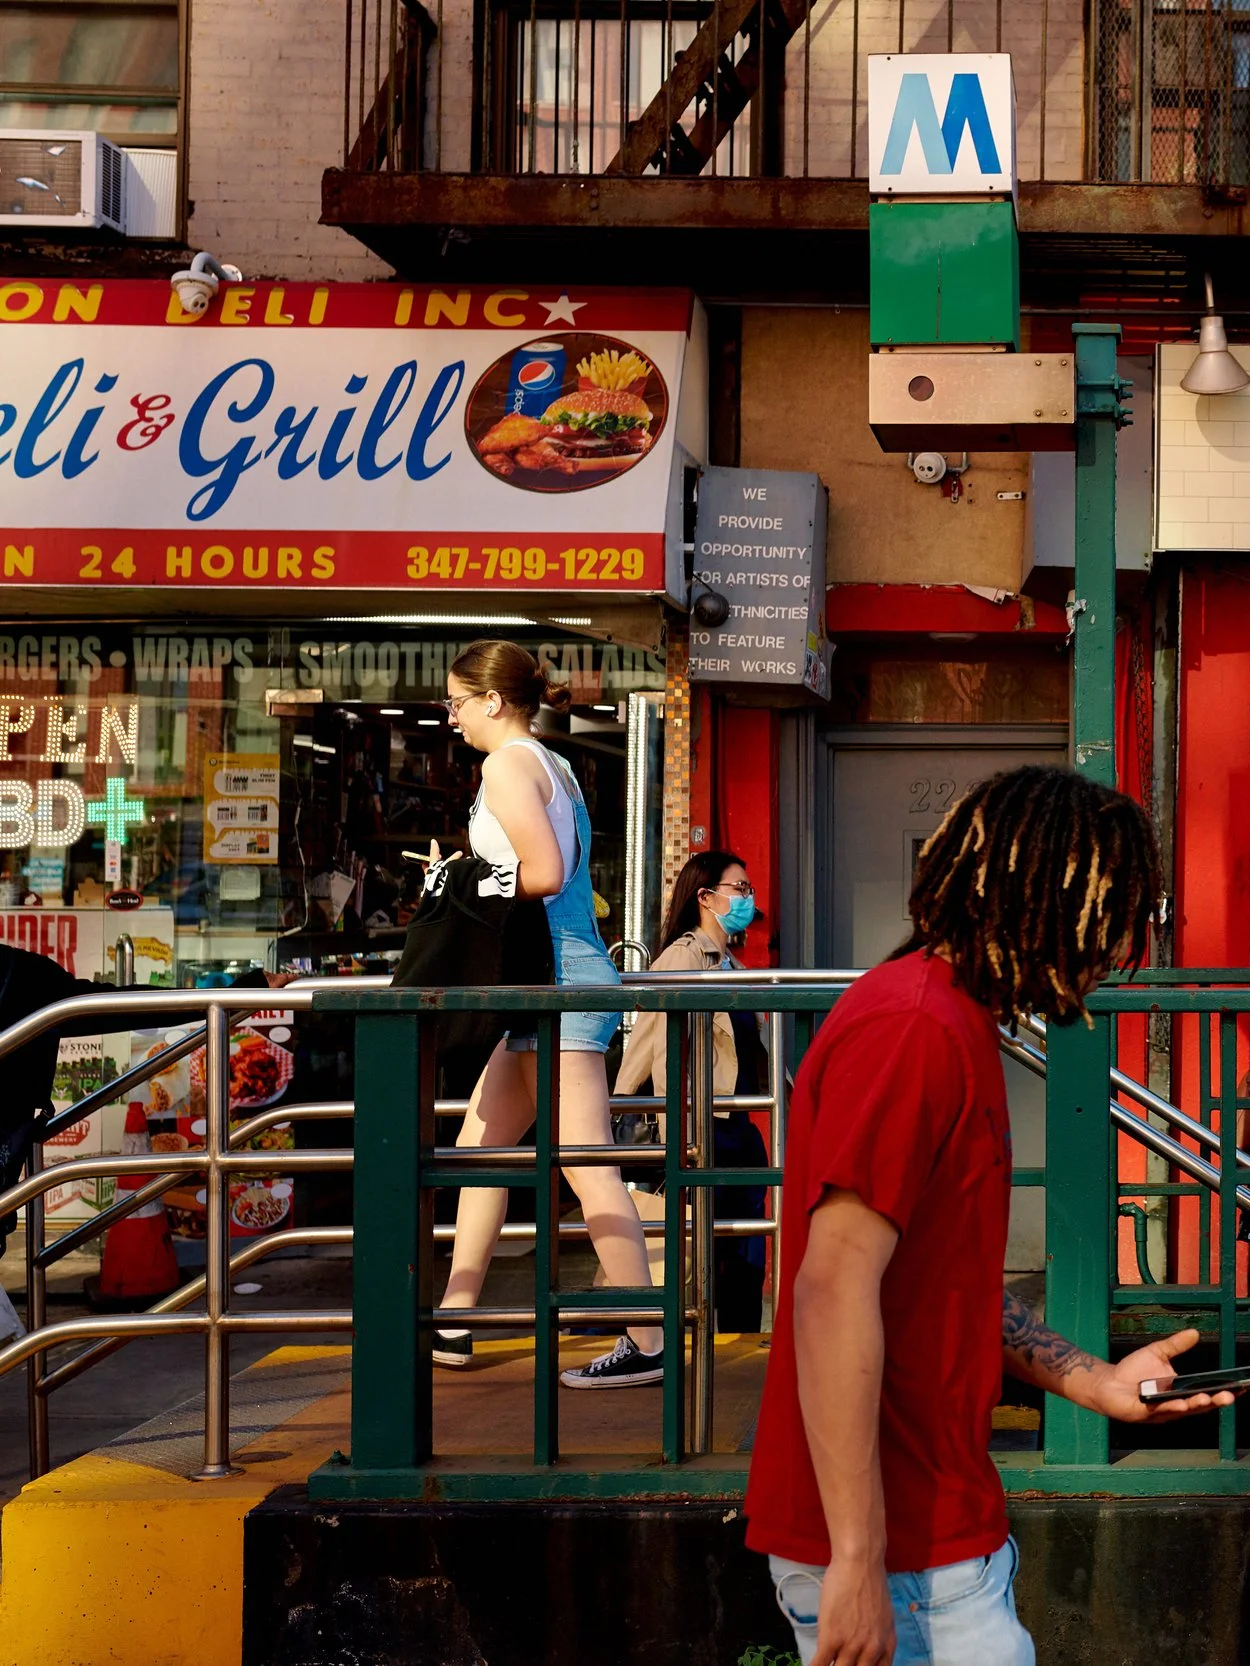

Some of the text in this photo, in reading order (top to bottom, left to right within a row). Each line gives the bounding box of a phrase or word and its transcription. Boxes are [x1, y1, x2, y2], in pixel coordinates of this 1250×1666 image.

[165, 286, 329, 325] DELI
[394, 289, 529, 327] INC
[116, 393, 175, 451] &
[179, 358, 465, 522] Grill
[742, 487, 767, 501] WE
[718, 515, 784, 531] PROVIDE
[79, 545, 136, 579] 24
[166, 545, 336, 579] HOURS
[406, 546, 645, 581] 347-799-1229
[700, 542, 807, 560] OPPORTUNITY
[726, 572, 788, 587] ARTISTS
[792, 575, 811, 588] OF
[690, 632, 786, 649] TO FEATURE
[132, 637, 254, 683] WRAPS
[300, 640, 468, 688] SMOOTHI
[689, 657, 797, 675] THEIR WORKS
[909, 778, 980, 814] 22
